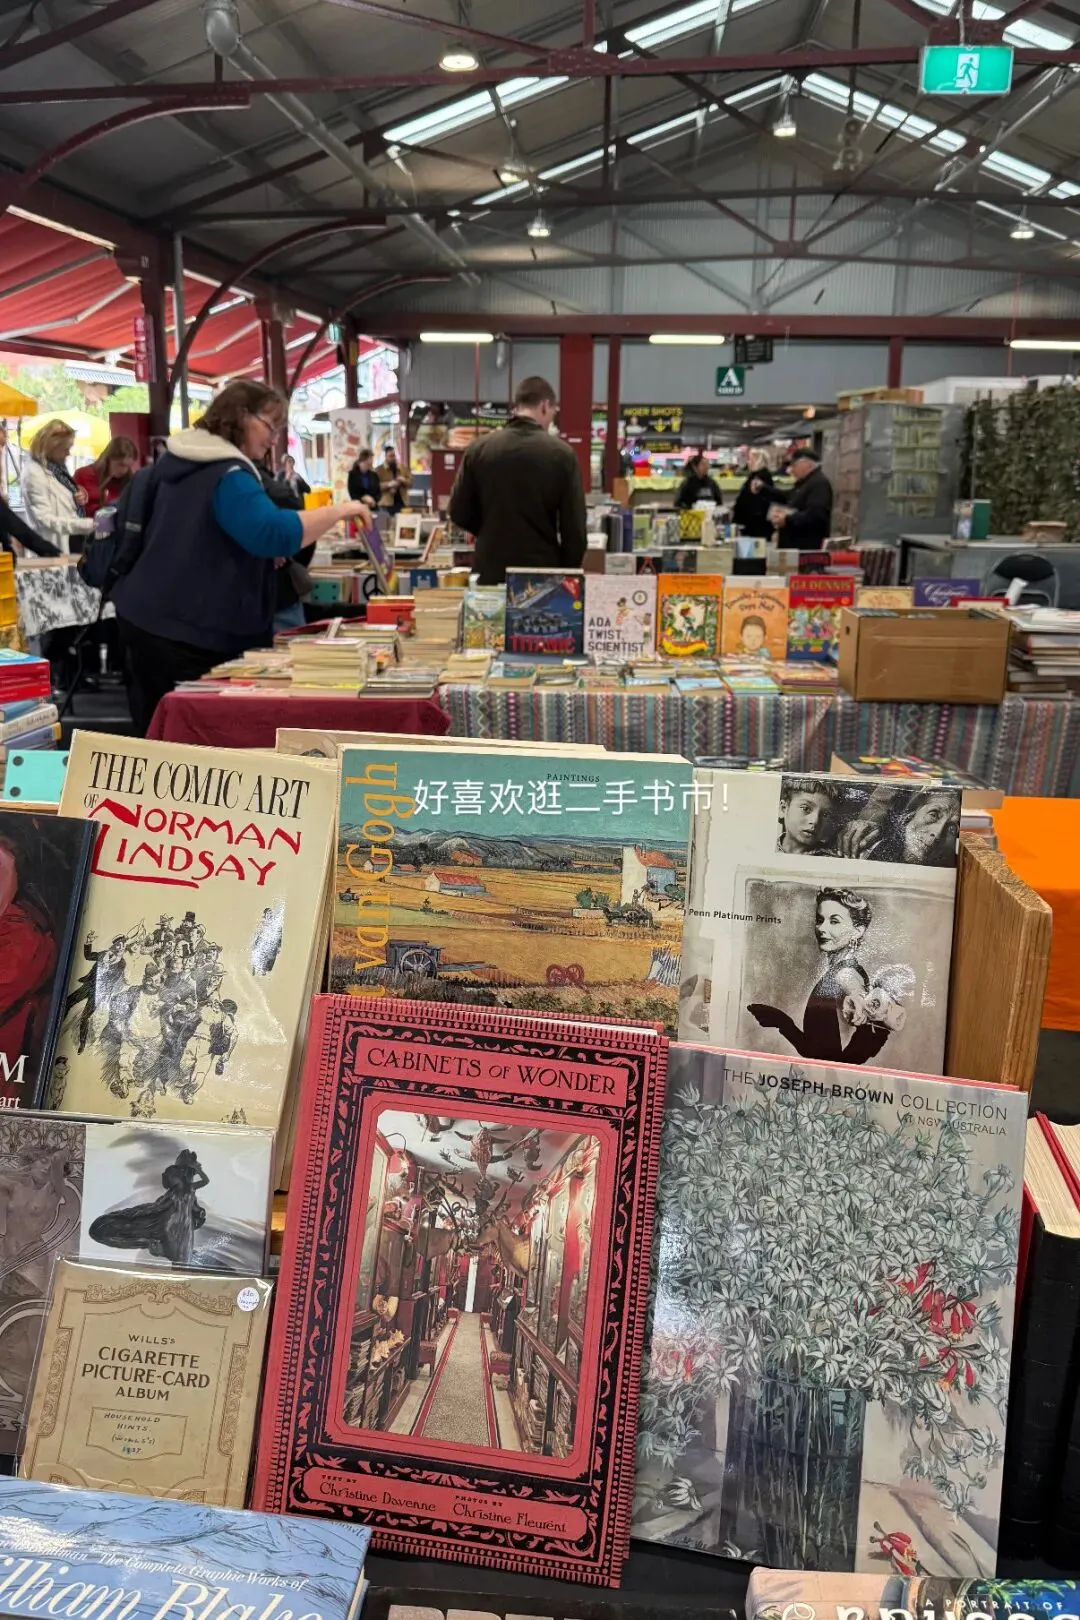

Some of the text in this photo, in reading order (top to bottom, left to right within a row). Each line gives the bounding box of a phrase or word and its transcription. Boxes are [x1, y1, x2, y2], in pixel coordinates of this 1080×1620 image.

[588, 617, 611, 628] ADA
[588, 629, 625, 640] TWIST,
[588, 641, 645, 653] SCIENTIST
[88, 750, 311, 820] THE COMIC ART
[547, 772, 600, 784] PAINTINGS
[83, 792, 100, 809] OF
[87, 797, 302, 856] NORMAN
[345, 761, 417, 881] Gogh
[90, 823, 277, 889] LINDSAY
[688, 908, 711, 918] Penn
[713, 910, 753, 922] Platinum
[755, 914, 782, 925] Prints
[366, 1048, 617, 1096] CABINETS OF WONDER
[723, 1068, 1008, 1121] THE JOSEPH BROWN COLLECTION
[98, 1346, 201, 1369] CIGARETTE
[81, 1363, 211, 1389] PICTURE-CARD
[114, 1387, 170, 1402] ALBUM
[103, 1412, 161, 1423] HOUSEHOLD
[319, 1482, 438, 1513] Christine Davenne
[452, 1503, 512, 1525] Christine
[99, 1552, 124, 1567] The
[126, 1555, 187, 1576] Complete
[189, 1564, 246, 1586] Graphic
[245, 1572, 290, 1588] Works
[290, 1578, 310, 1592] of
[0, 1555, 325, 1620] lliam Blak
[925, 1598, 1063, 1610] A PORTRAIT OF
